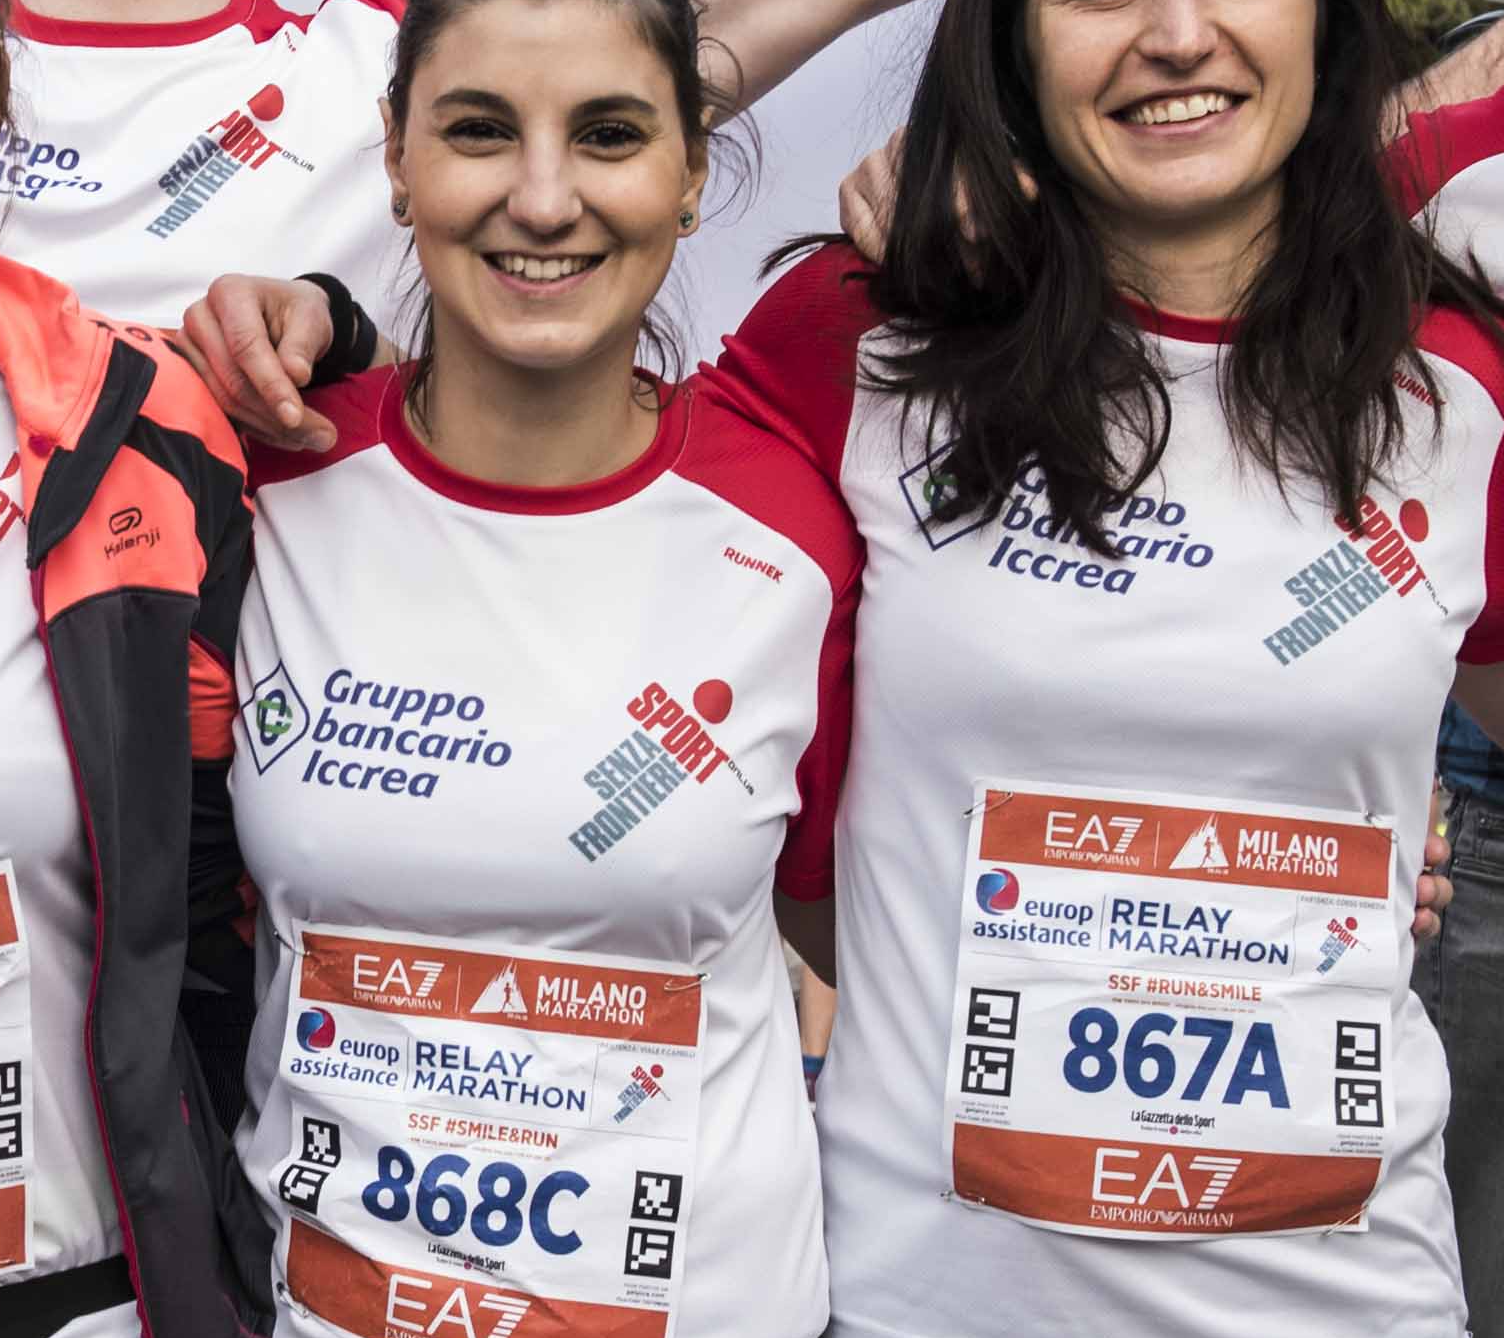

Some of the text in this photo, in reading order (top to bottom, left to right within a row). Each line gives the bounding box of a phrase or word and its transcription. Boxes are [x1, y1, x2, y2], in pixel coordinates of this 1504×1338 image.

[158, 133, 221, 198] SENZA
[145, 150, 242, 240] FRONTIERE
[724, 546, 784, 583] RUNNEK
[989, 537, 1136, 595] Iccrea
[1283, 540, 1367, 608] SENZA
[1264, 566, 1391, 667] FRONTIERE
[324, 669, 486, 723] Gruppo
[312, 707, 512, 767] bancario
[626, 681, 730, 785] SPORT
[302, 750, 440, 799] Iccrea
[583, 729, 666, 803] SENZA
[568, 751, 688, 862] FRONTIERE
[1045, 810, 1338, 862] EA7 MILANO
[1236, 856, 1338, 878] MARATHON
[1025, 901, 1093, 923] europ
[1111, 898, 1233, 933] RELAY
[1326, 916, 1359, 950] SPORT
[973, 921, 1090, 948] assistance
[1109, 932, 1288, 965] MARATHON
[353, 954, 647, 1011] EA7 MILANO
[1109, 974, 1262, 1002] SSF #RUN&SMILE
[535, 999, 644, 1026] MARATHON
[291, 1057, 398, 1087] assistance
[340, 1037, 399, 1065] europ
[416, 1042, 533, 1078] RELAY
[1063, 1006, 1291, 1109] 867A
[412, 1072, 586, 1111] MARATHON
[631, 1065, 663, 1098] SPORT
[408, 1113, 440, 1131] SSF
[445, 1118, 559, 1150] #SMILE&RUN
[361, 1145, 591, 1255] 868C
[1093, 1147, 1242, 1210] EA7
[1089, 1205, 1234, 1228] EMPORIO ARMANI
